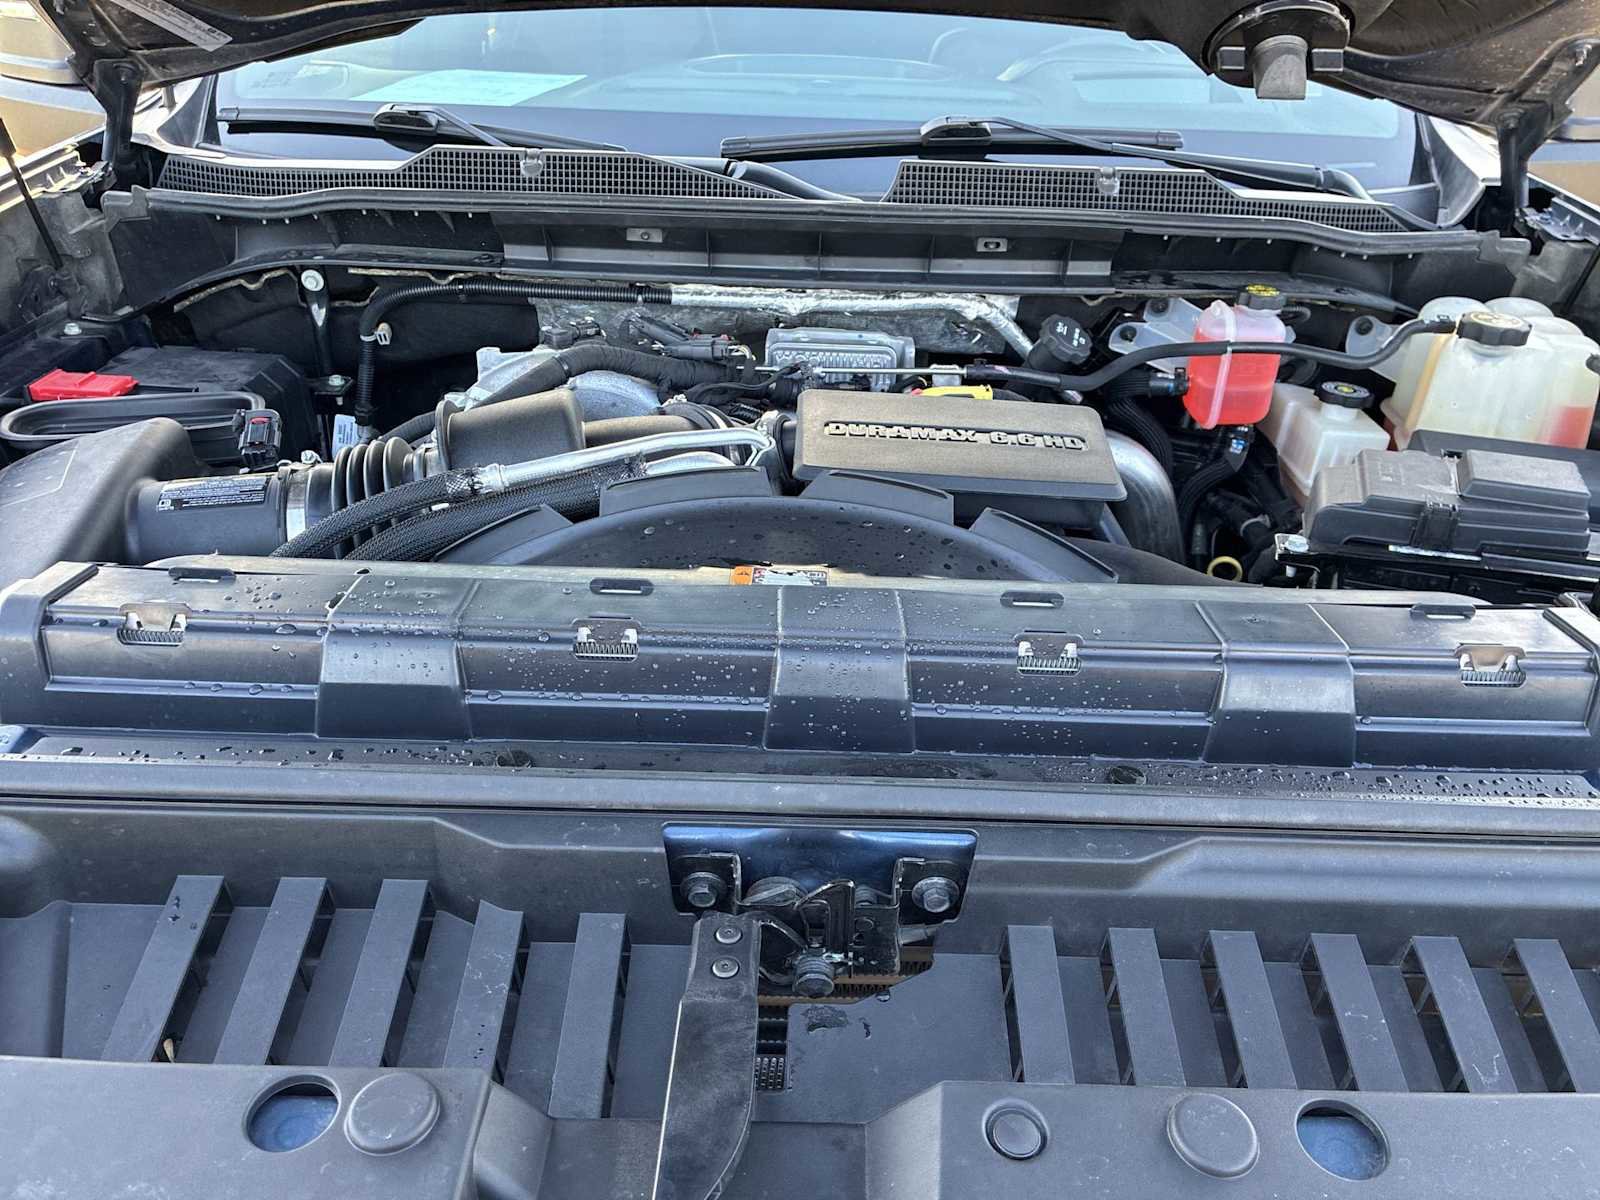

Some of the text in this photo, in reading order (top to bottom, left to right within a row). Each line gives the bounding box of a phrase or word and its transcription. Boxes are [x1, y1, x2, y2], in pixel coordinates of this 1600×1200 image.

[827, 422, 1085, 450] DURAMAX 6.6 HD
